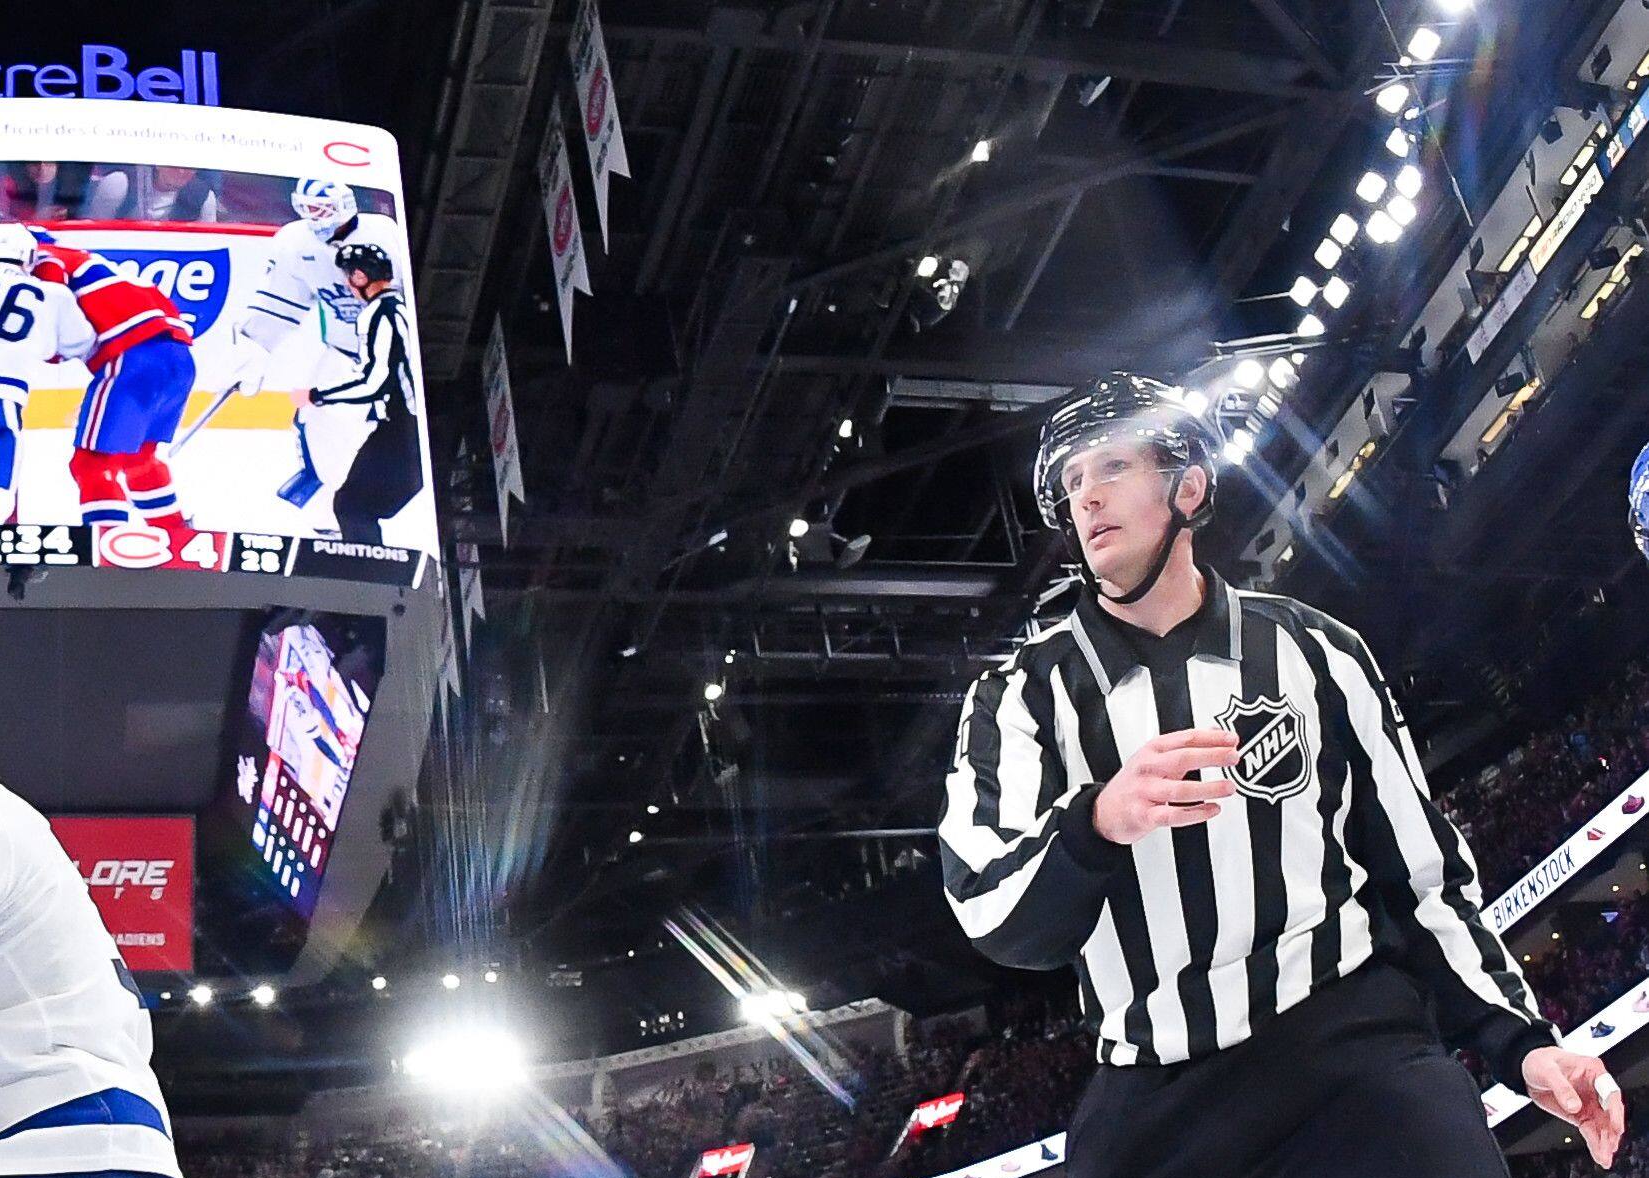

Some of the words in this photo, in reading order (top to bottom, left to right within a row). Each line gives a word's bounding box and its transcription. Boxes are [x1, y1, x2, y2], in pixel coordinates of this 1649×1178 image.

[179, 532, 219, 569] 4
[312, 539, 411, 563] PUNITIONS
[1243, 720, 1295, 780] NHL
[1492, 843, 1577, 930] BIRKENSTOCK
